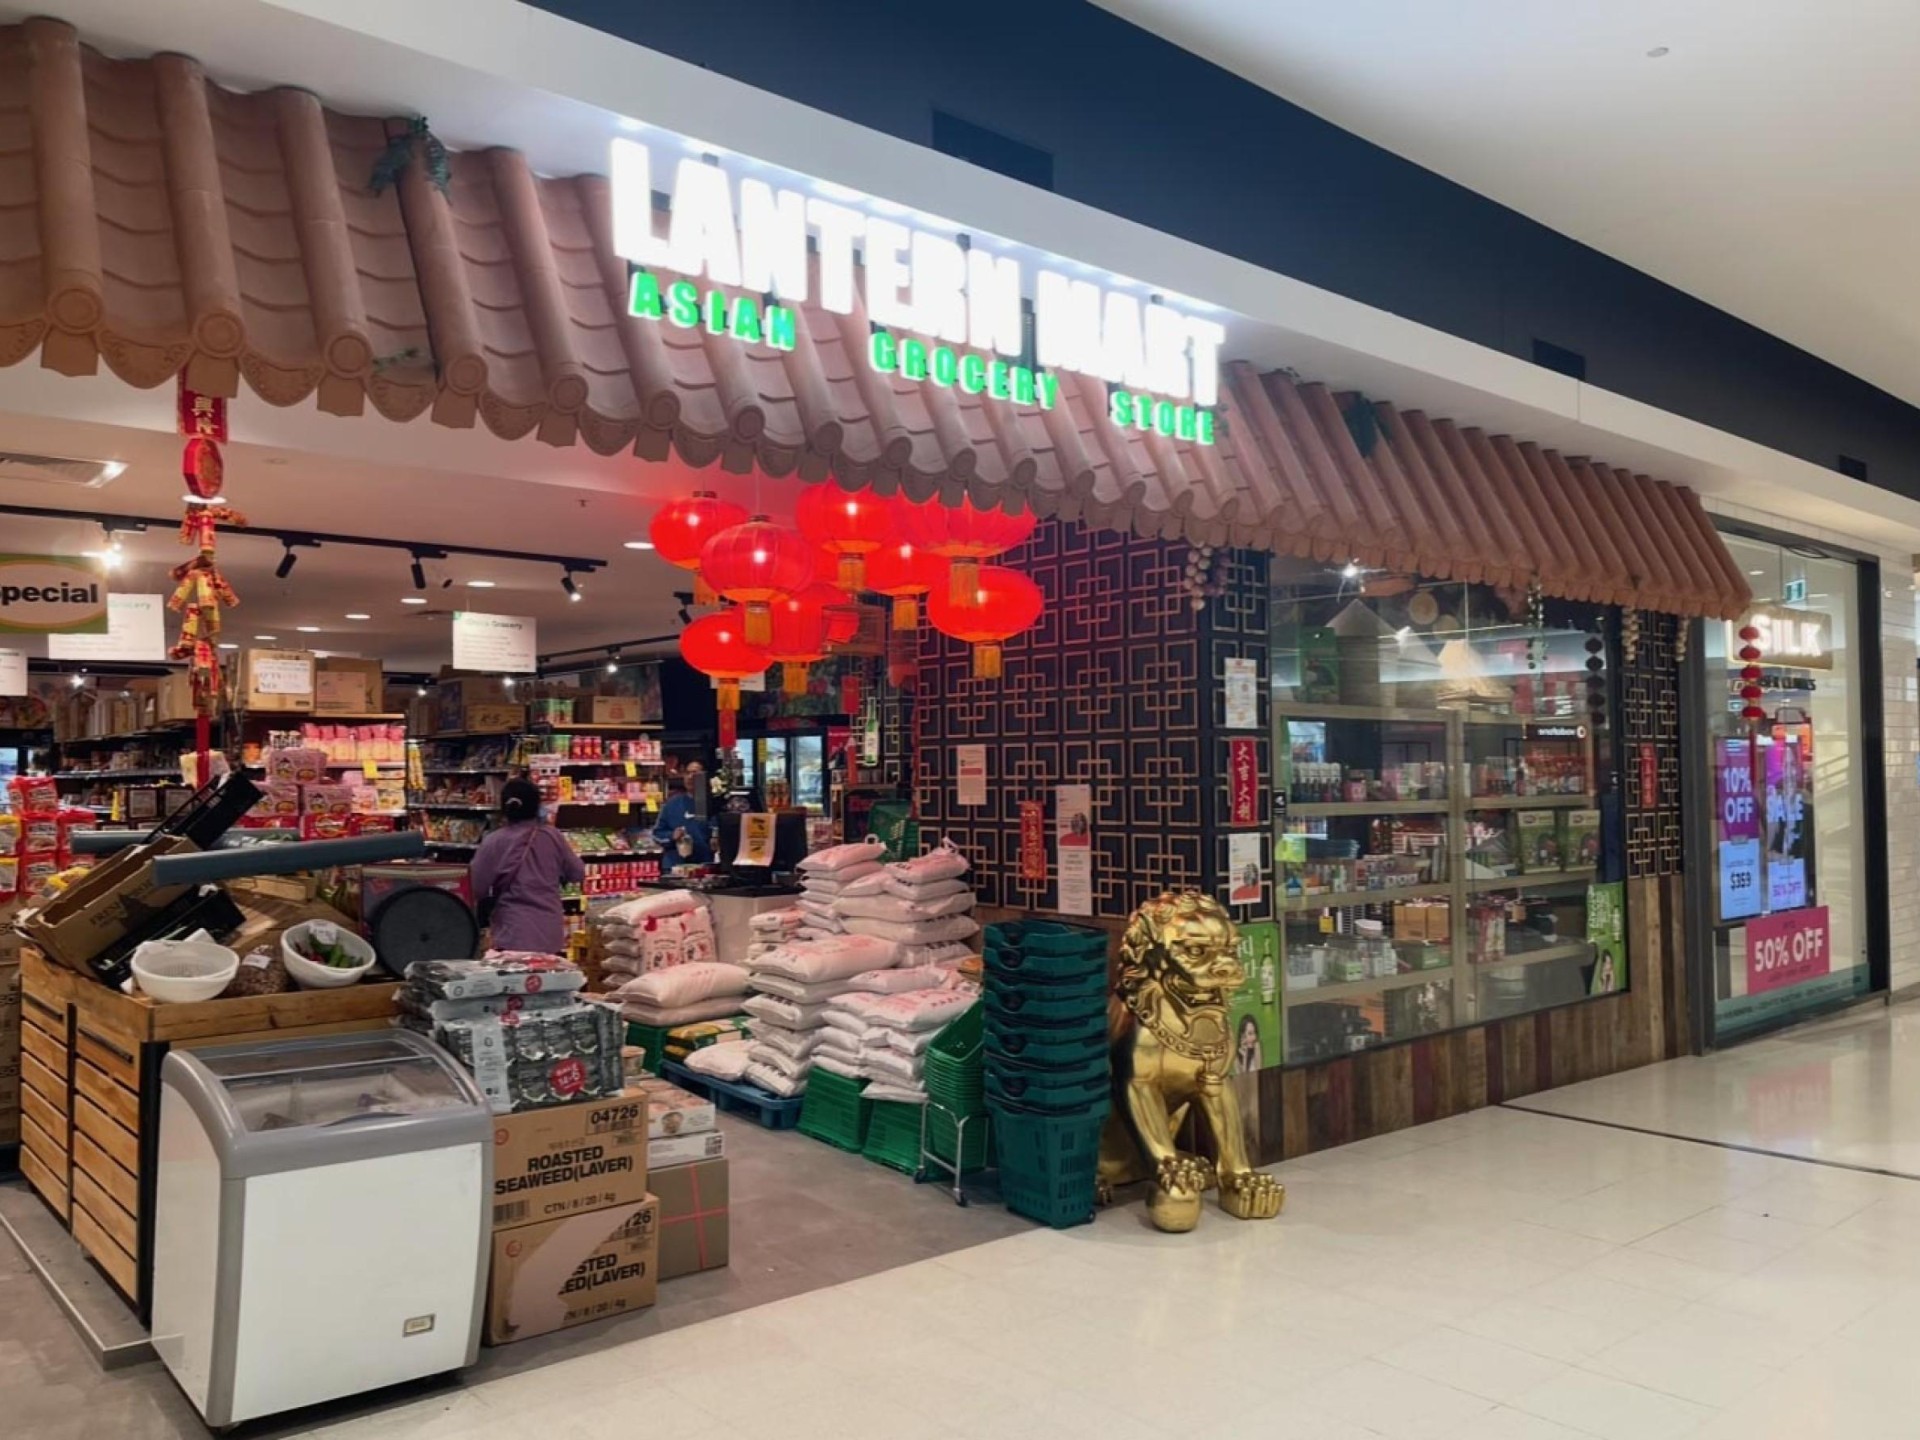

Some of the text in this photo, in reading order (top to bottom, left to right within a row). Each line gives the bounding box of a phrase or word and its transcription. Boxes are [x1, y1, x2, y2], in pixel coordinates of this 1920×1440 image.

[609, 136, 1226, 406] LANTERN MART
[628, 271, 1216, 445] ASIAN GROCERY STORE
[0, 582, 98, 606] pecial
[1750, 614, 1823, 657] SILK
[1723, 766, 1752, 793] 10%
[1724, 796, 1754, 824] OFF
[1754, 927, 1824, 972] 50% OFF
[591, 1104, 638, 1125] 04726
[527, 1146, 605, 1172] ROASTED
[494, 1156, 633, 1195] SEAWEED(LAVER)
[572, 1253, 618, 1276] STED
